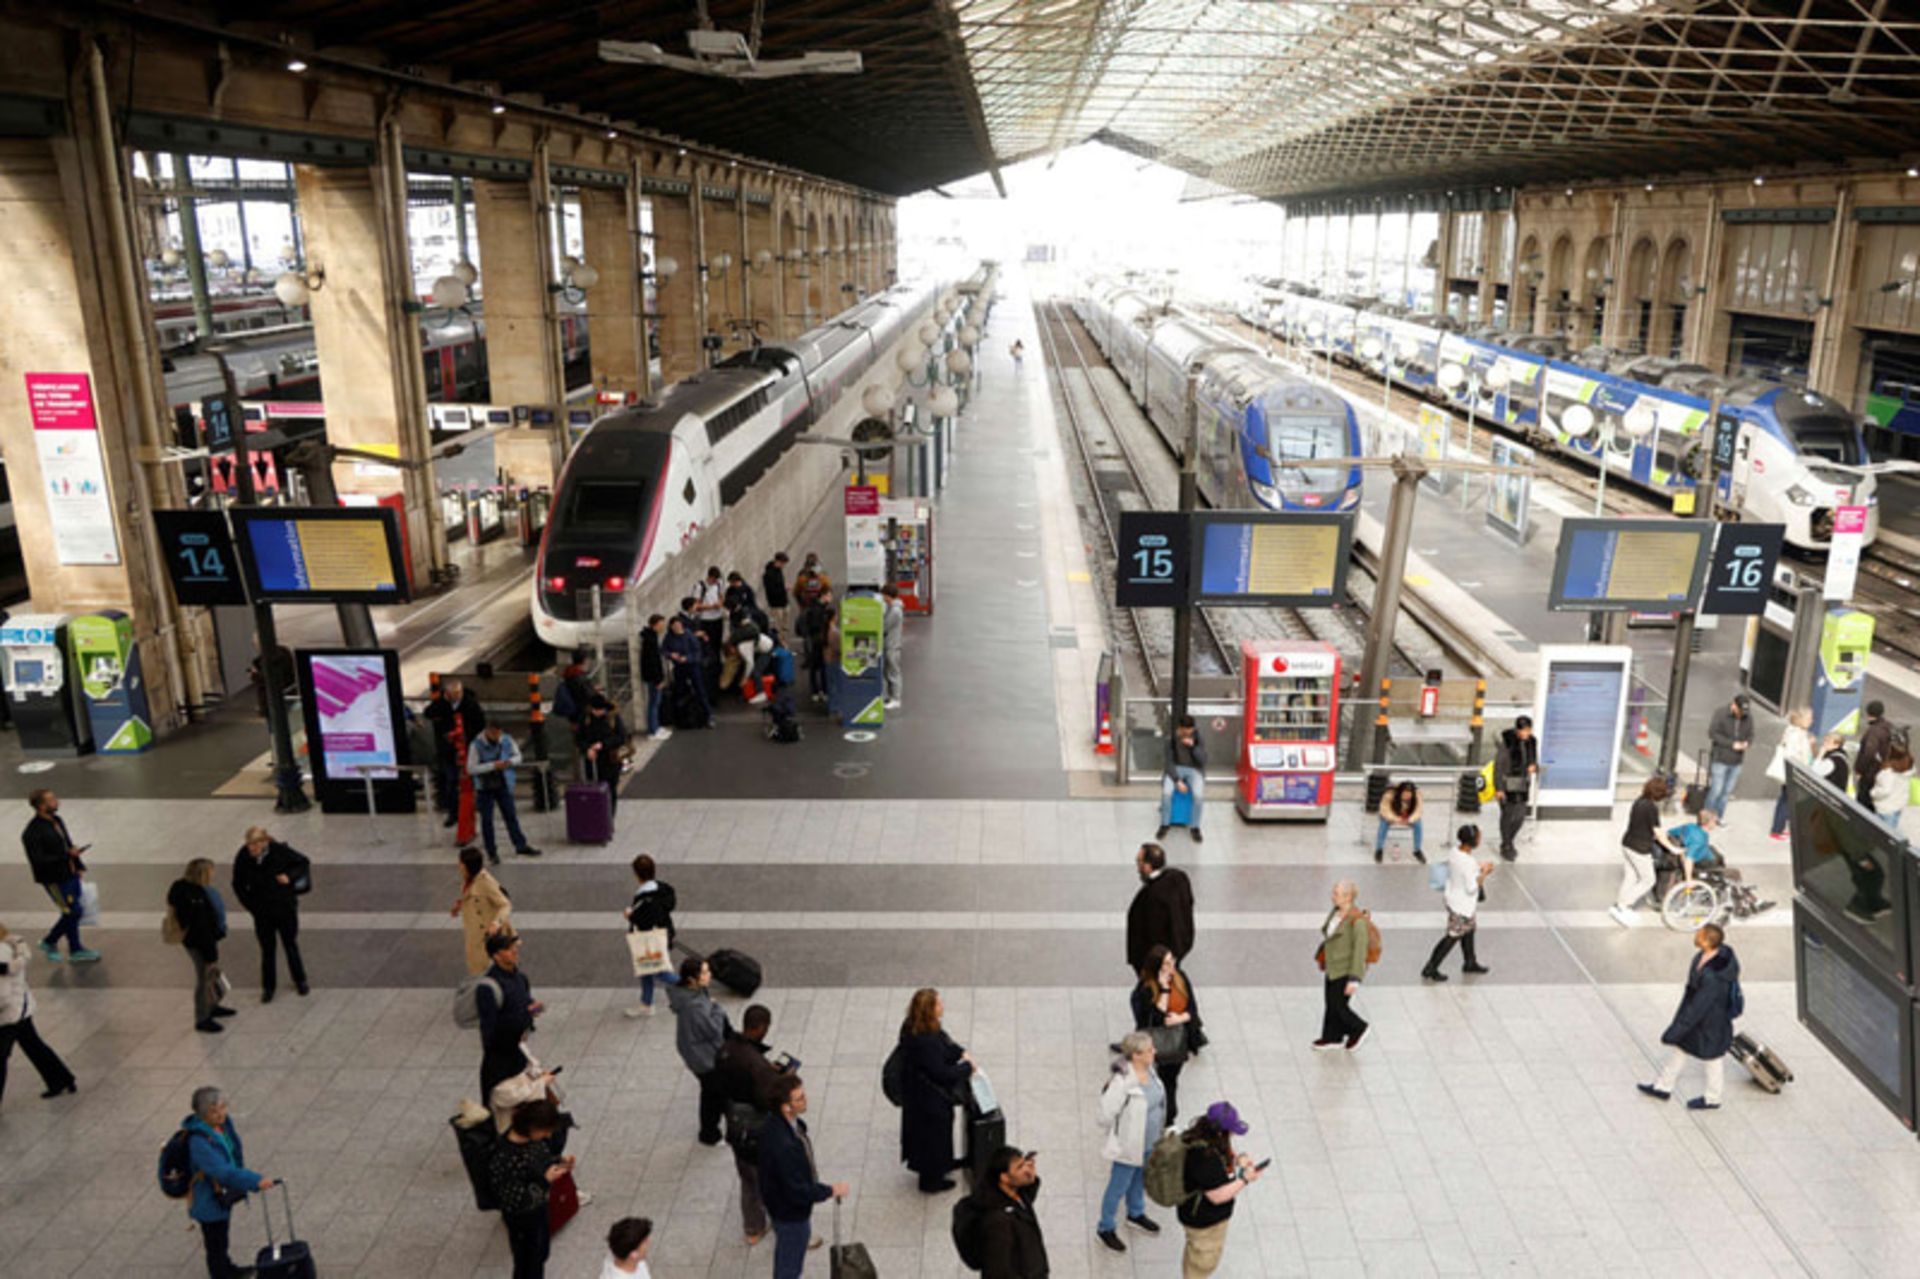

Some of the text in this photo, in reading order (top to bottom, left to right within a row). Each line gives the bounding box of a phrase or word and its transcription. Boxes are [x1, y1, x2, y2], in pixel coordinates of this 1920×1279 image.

[179, 548, 225, 575] 14
[1132, 549, 1173, 577] 15
[1725, 559, 1764, 587] 16
